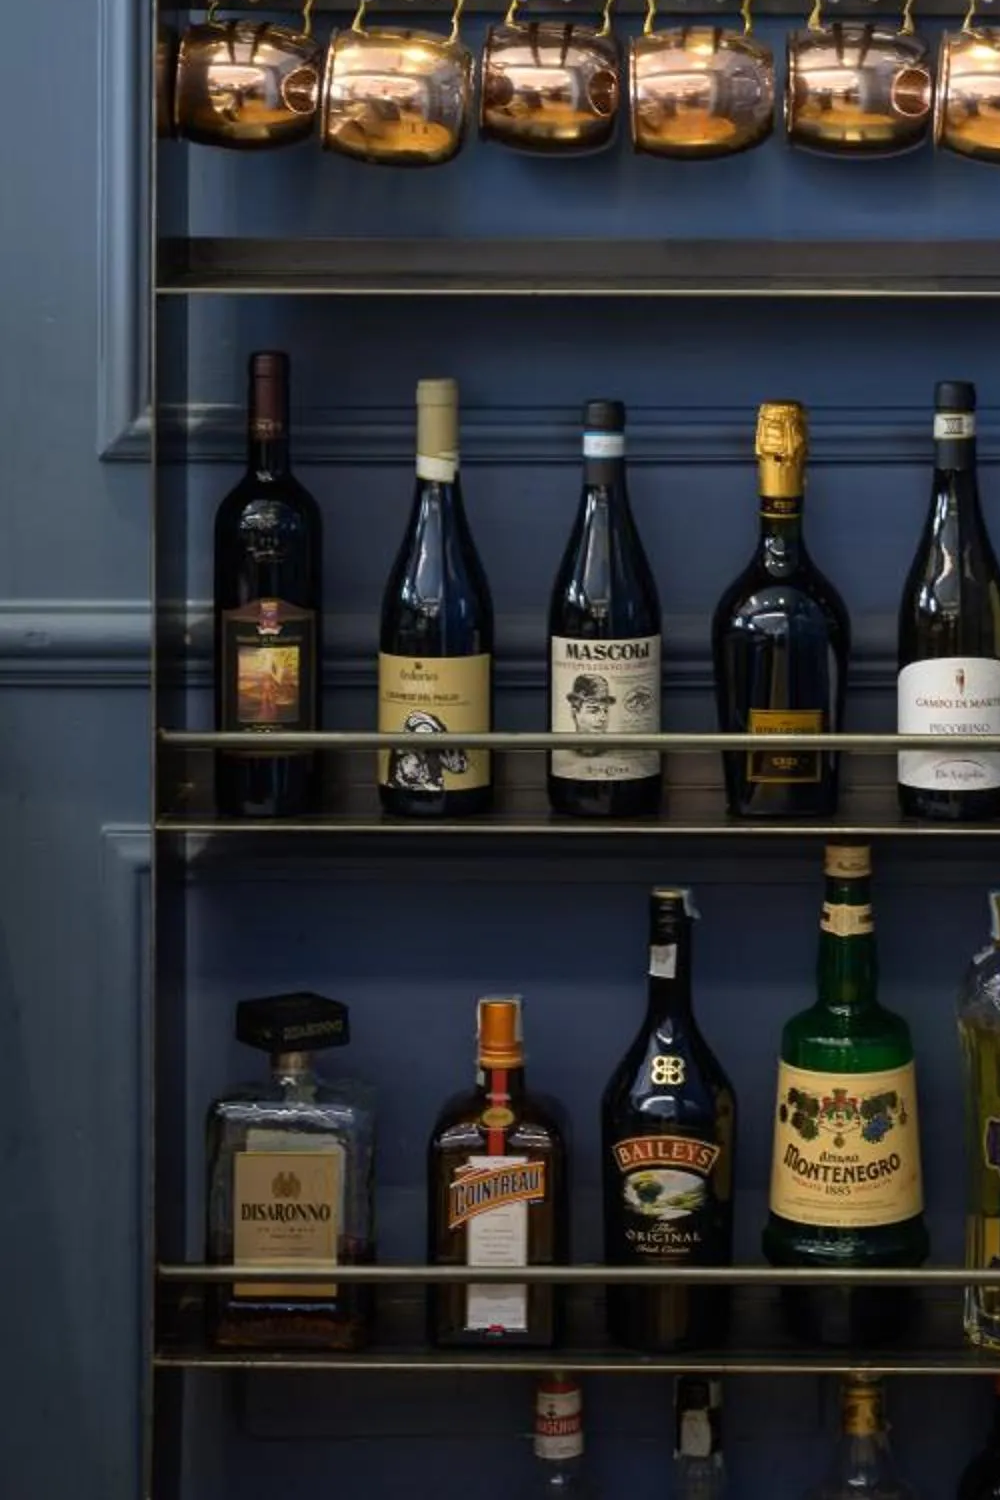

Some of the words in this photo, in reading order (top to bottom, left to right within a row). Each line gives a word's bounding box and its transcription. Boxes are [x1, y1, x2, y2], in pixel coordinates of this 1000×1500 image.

[618, 1140, 714, 1165] BAILEYS
[783, 1143, 902, 1184] MONTENEGRO
[454, 1169, 541, 1216] COINTREAU
[240, 1203, 332, 1224] DISARONNO
[625, 1230, 702, 1243] ORIGINAL
